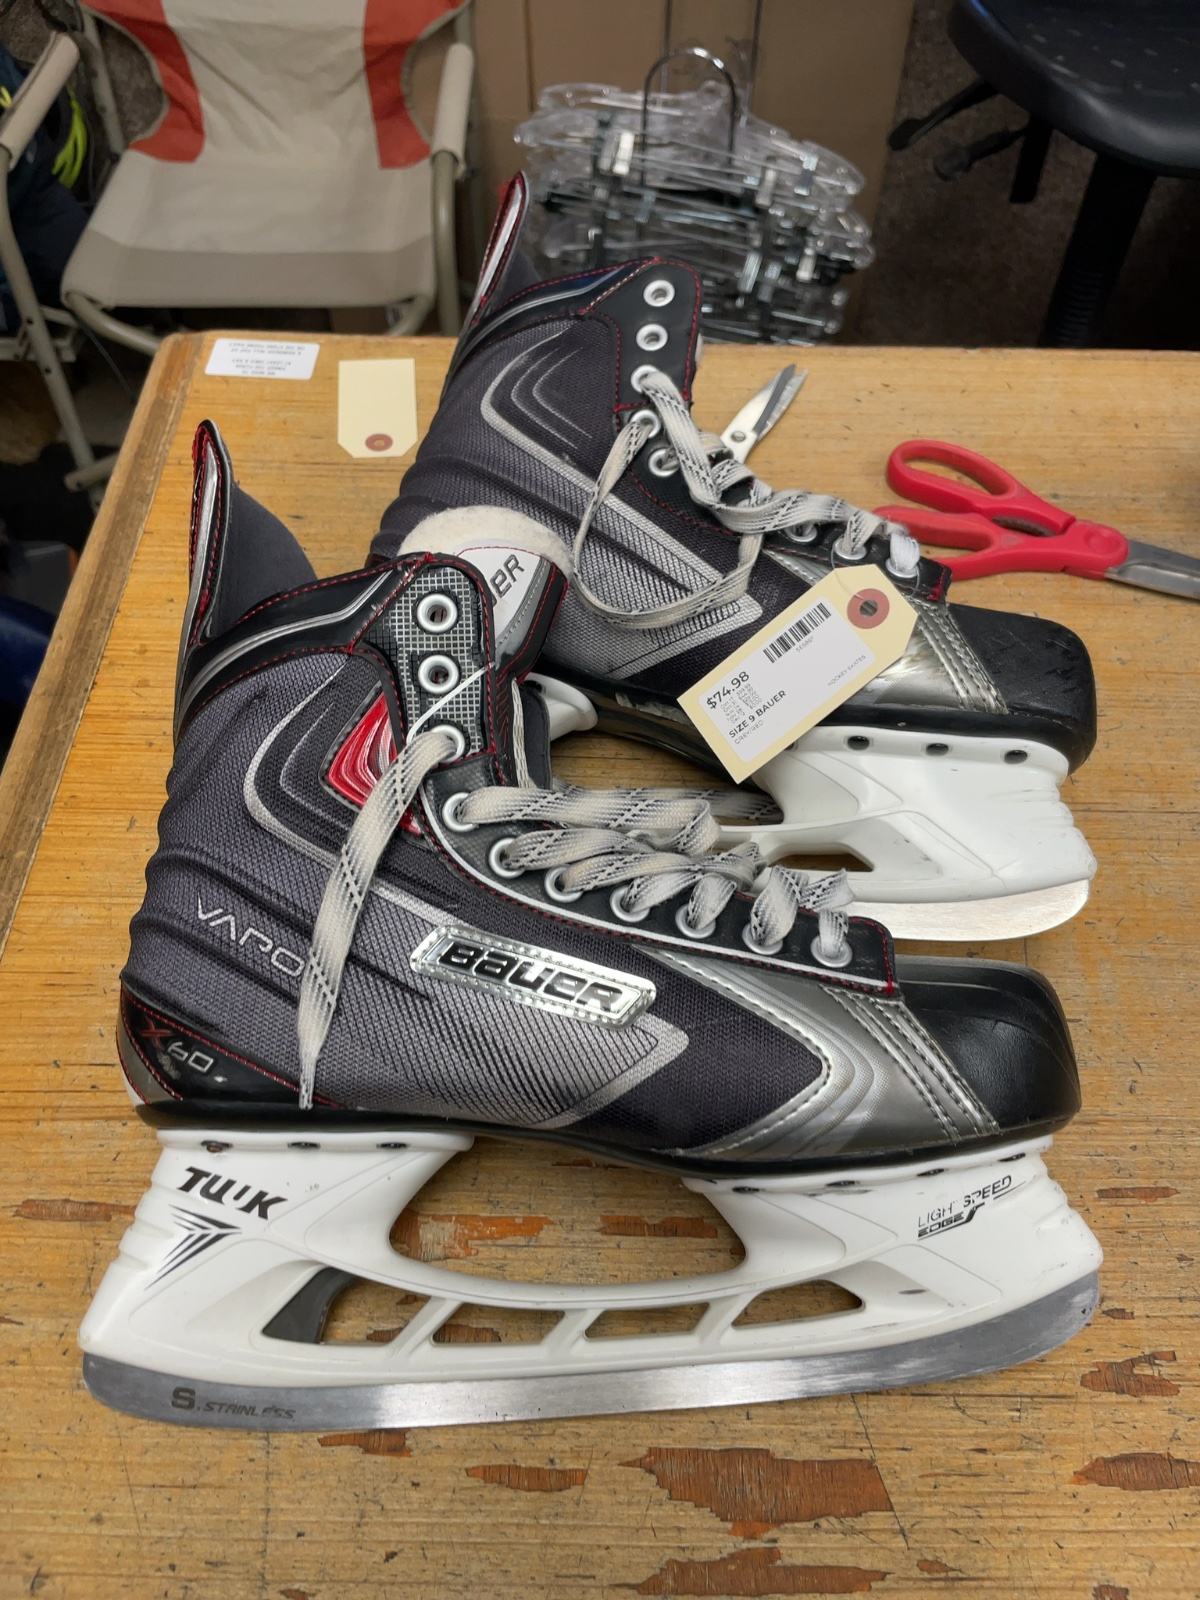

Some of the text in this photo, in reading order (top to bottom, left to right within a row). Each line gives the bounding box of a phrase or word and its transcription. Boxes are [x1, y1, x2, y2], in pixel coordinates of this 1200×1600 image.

[827, 654, 866, 687] HOCKEY SKATES
[707, 671, 750, 709] $74.98
[729, 690, 787, 738] SIZE 9 BAUER
[437, 941, 625, 1013] BAUER
[918, 1211, 965, 1237] EDGE
